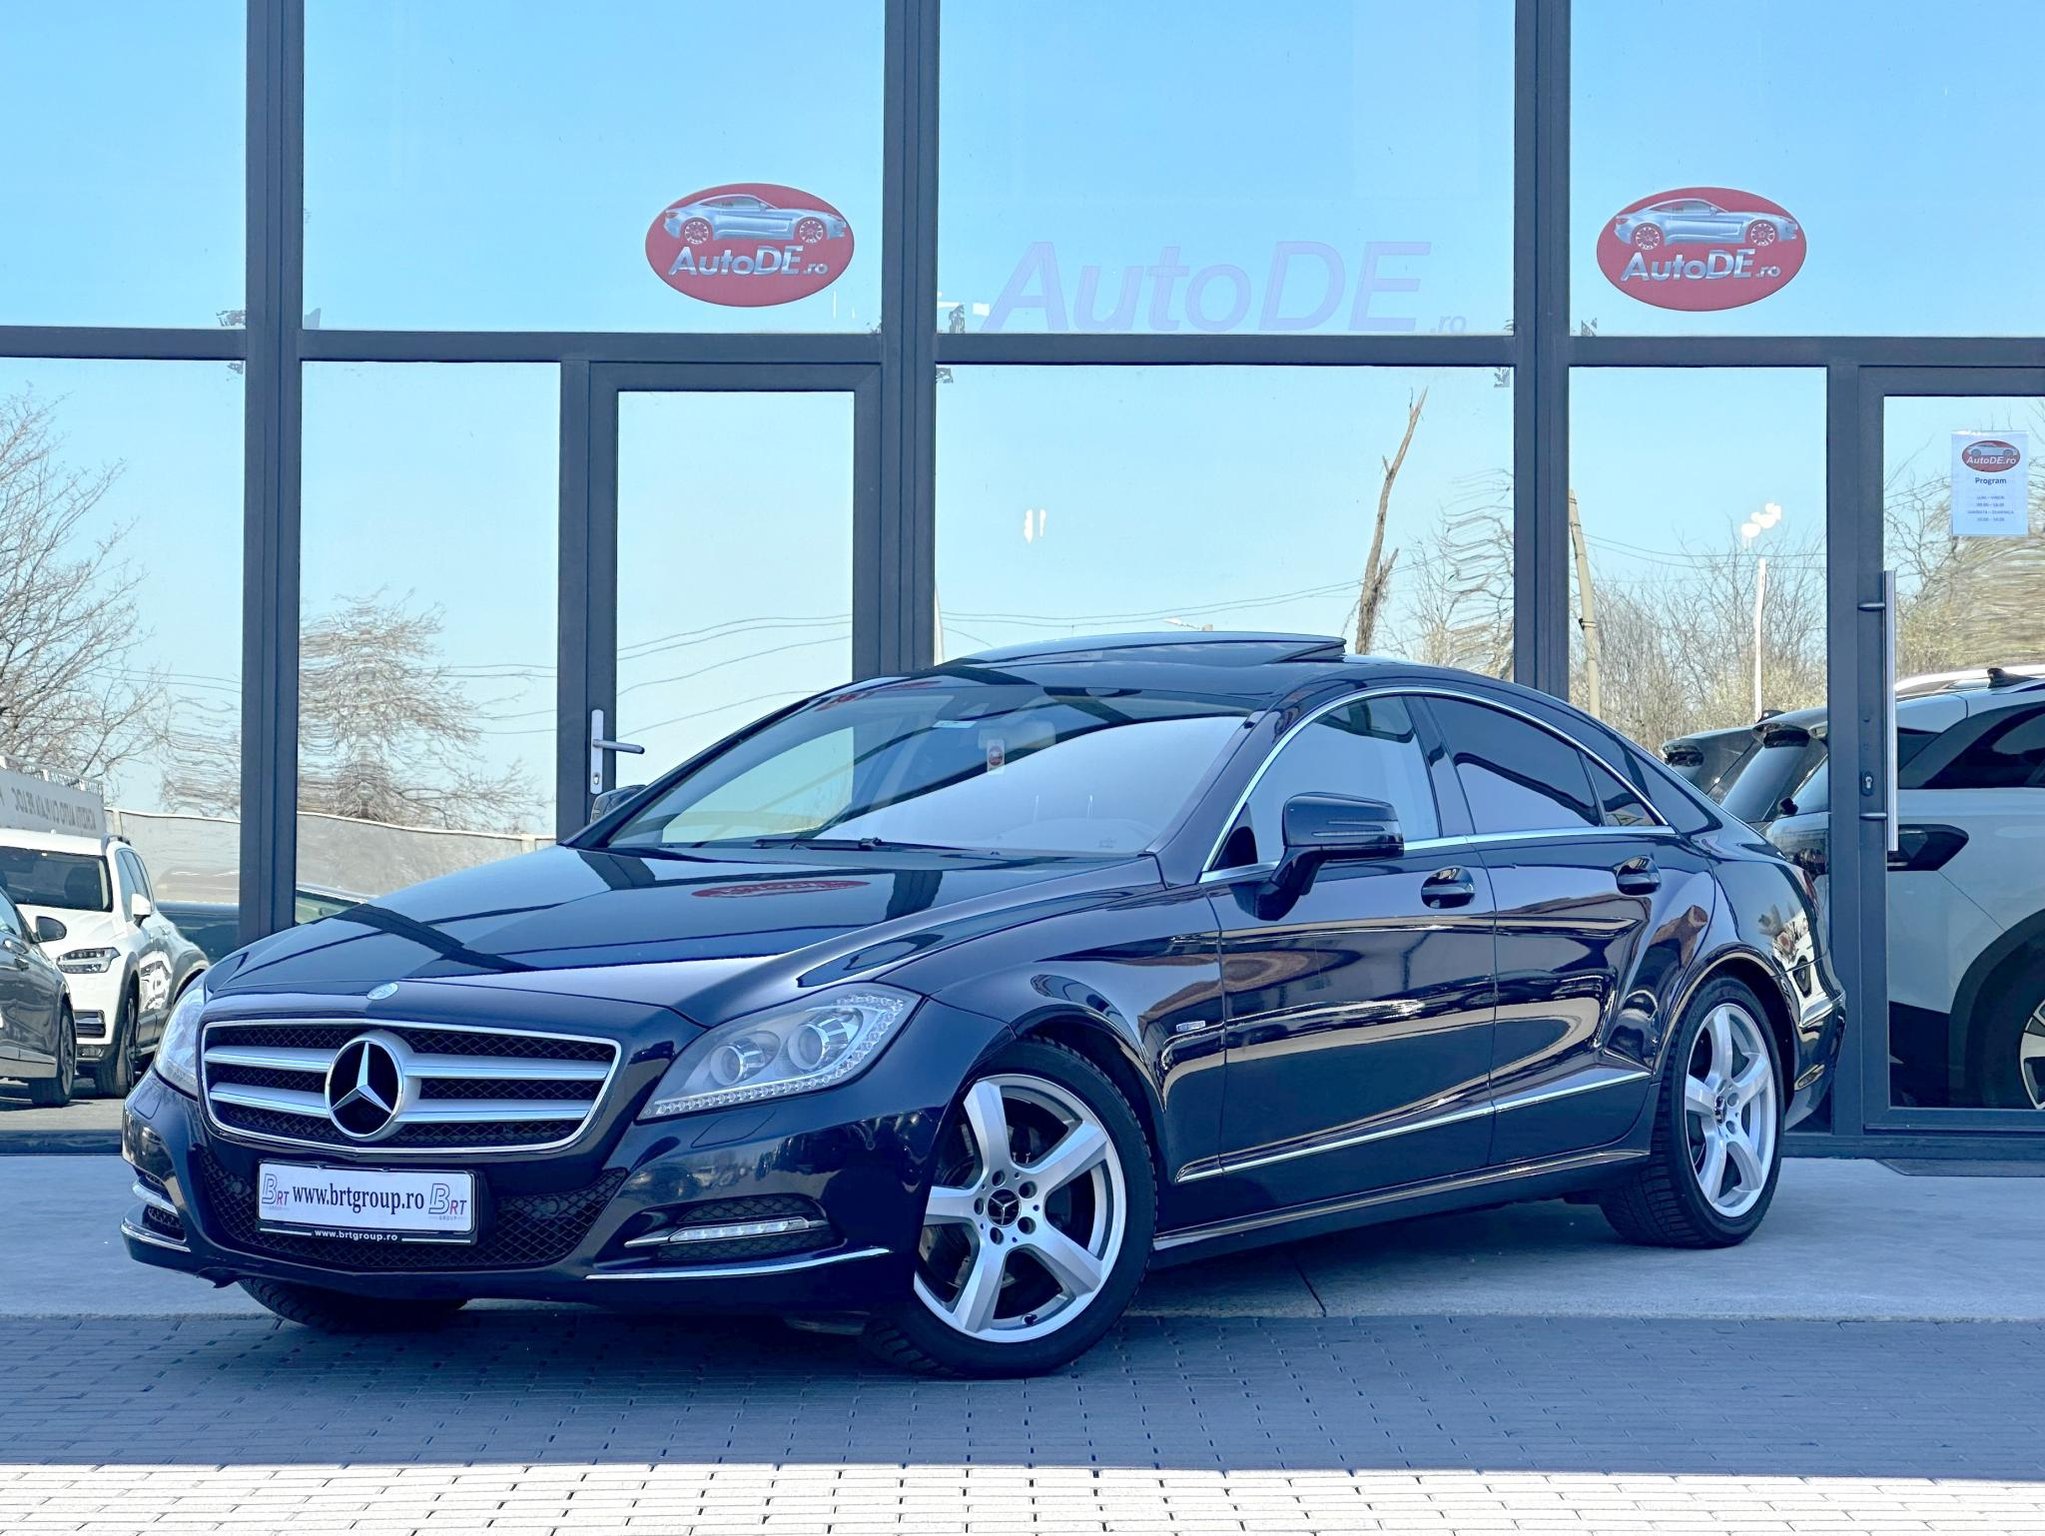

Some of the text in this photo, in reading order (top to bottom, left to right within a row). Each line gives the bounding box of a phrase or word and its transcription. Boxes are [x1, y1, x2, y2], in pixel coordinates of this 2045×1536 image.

[1966, 455, 2017, 465] AutoDE.ro
[1975, 477, 2007, 486] Program
[292, 1182, 425, 1215] www.brtgroup.ro
[428, 1182, 468, 1215] BRT
[314, 1228, 398, 1242] www.brtgroup.ro
